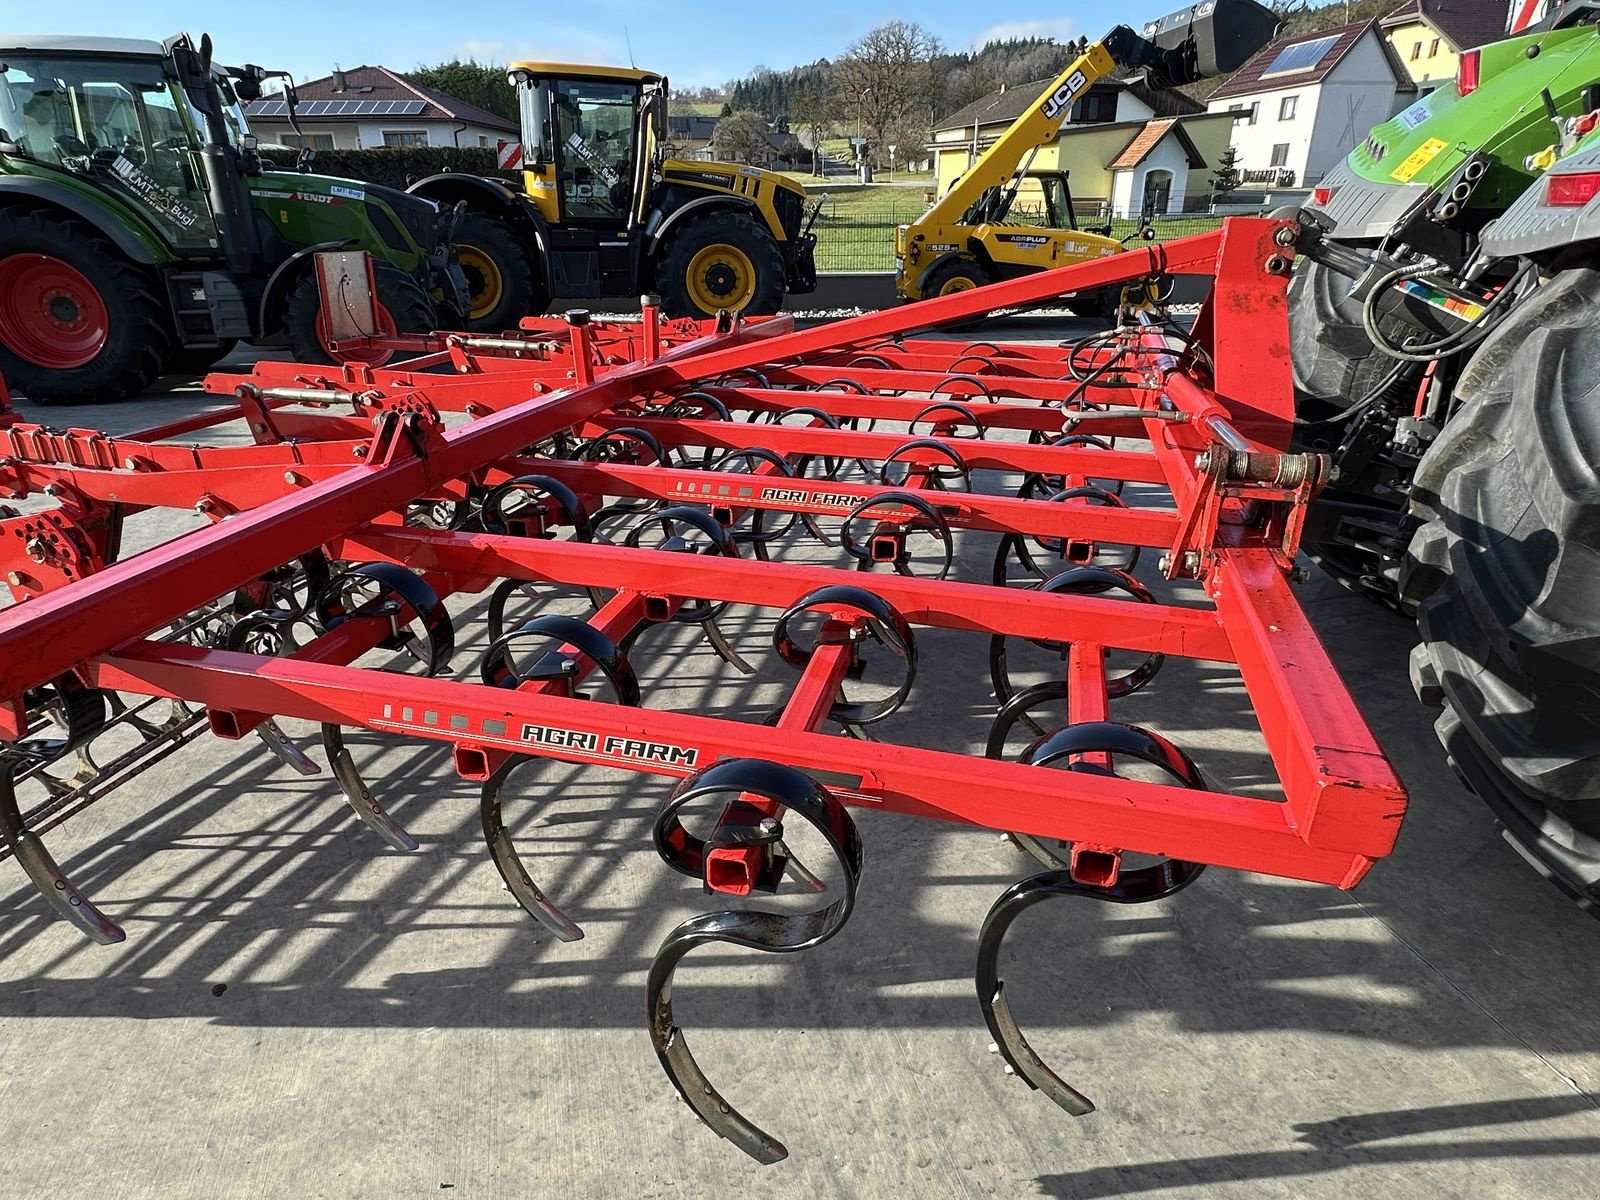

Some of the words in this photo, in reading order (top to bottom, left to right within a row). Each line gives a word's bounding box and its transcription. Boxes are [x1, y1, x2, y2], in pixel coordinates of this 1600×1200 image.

[1045, 71, 1086, 118] JCB
[577, 144, 593, 160] LMT
[296, 191, 334, 204] FENDT
[565, 184, 608, 198] JCB
[128, 174, 154, 193] LMT
[170, 205, 196, 227] Bugl
[762, 487, 809, 503] AGRI
[522, 724, 598, 751] AGRI
[604, 736, 699, 766] FARM
